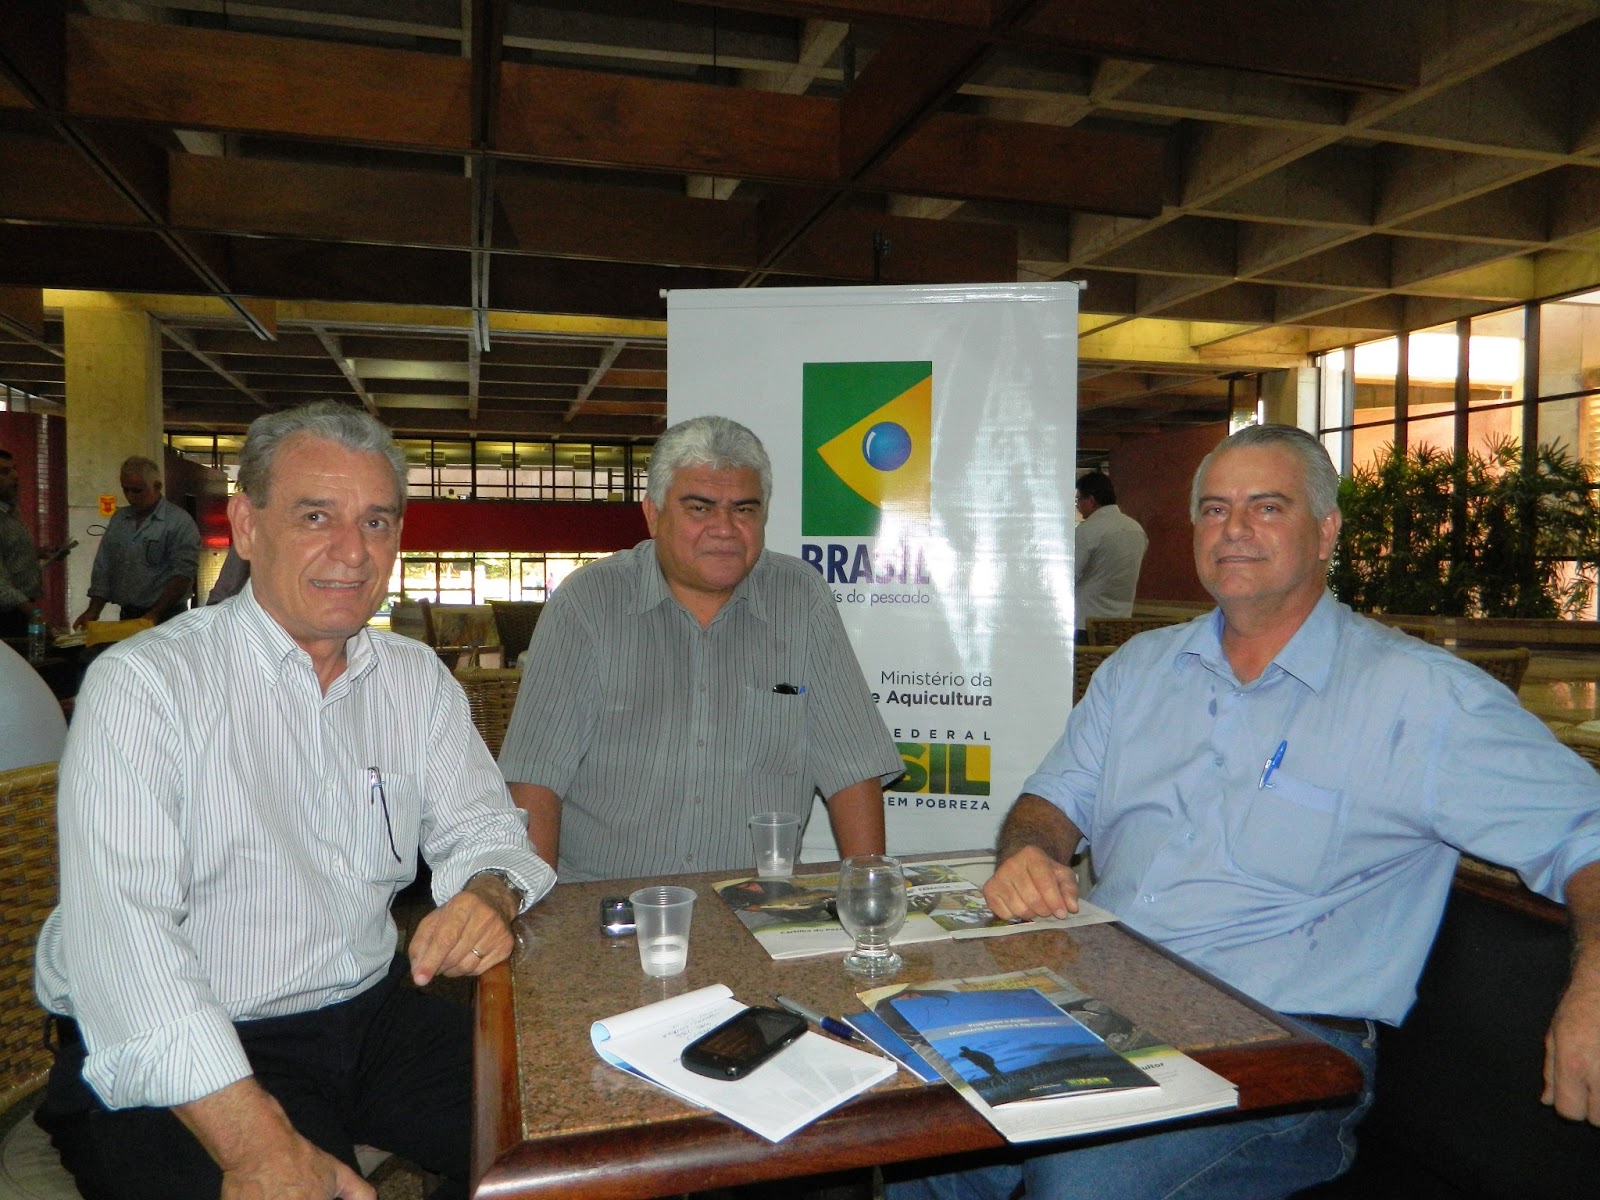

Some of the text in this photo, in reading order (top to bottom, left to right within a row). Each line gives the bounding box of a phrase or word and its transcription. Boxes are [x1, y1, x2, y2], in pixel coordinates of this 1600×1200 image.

[801, 544, 930, 585] BRASIL
[847, 589, 866, 603] do
[870, 589, 930, 606] pescado
[881, 671, 992, 687] Ministério da
[872, 690, 992, 708] e Aquicultura
[894, 728, 991, 740] EDERAL
[890, 742, 990, 796] SIL
[888, 797, 990, 811] EM POBREZA
[1141, 1062, 1165, 1071] ultor
